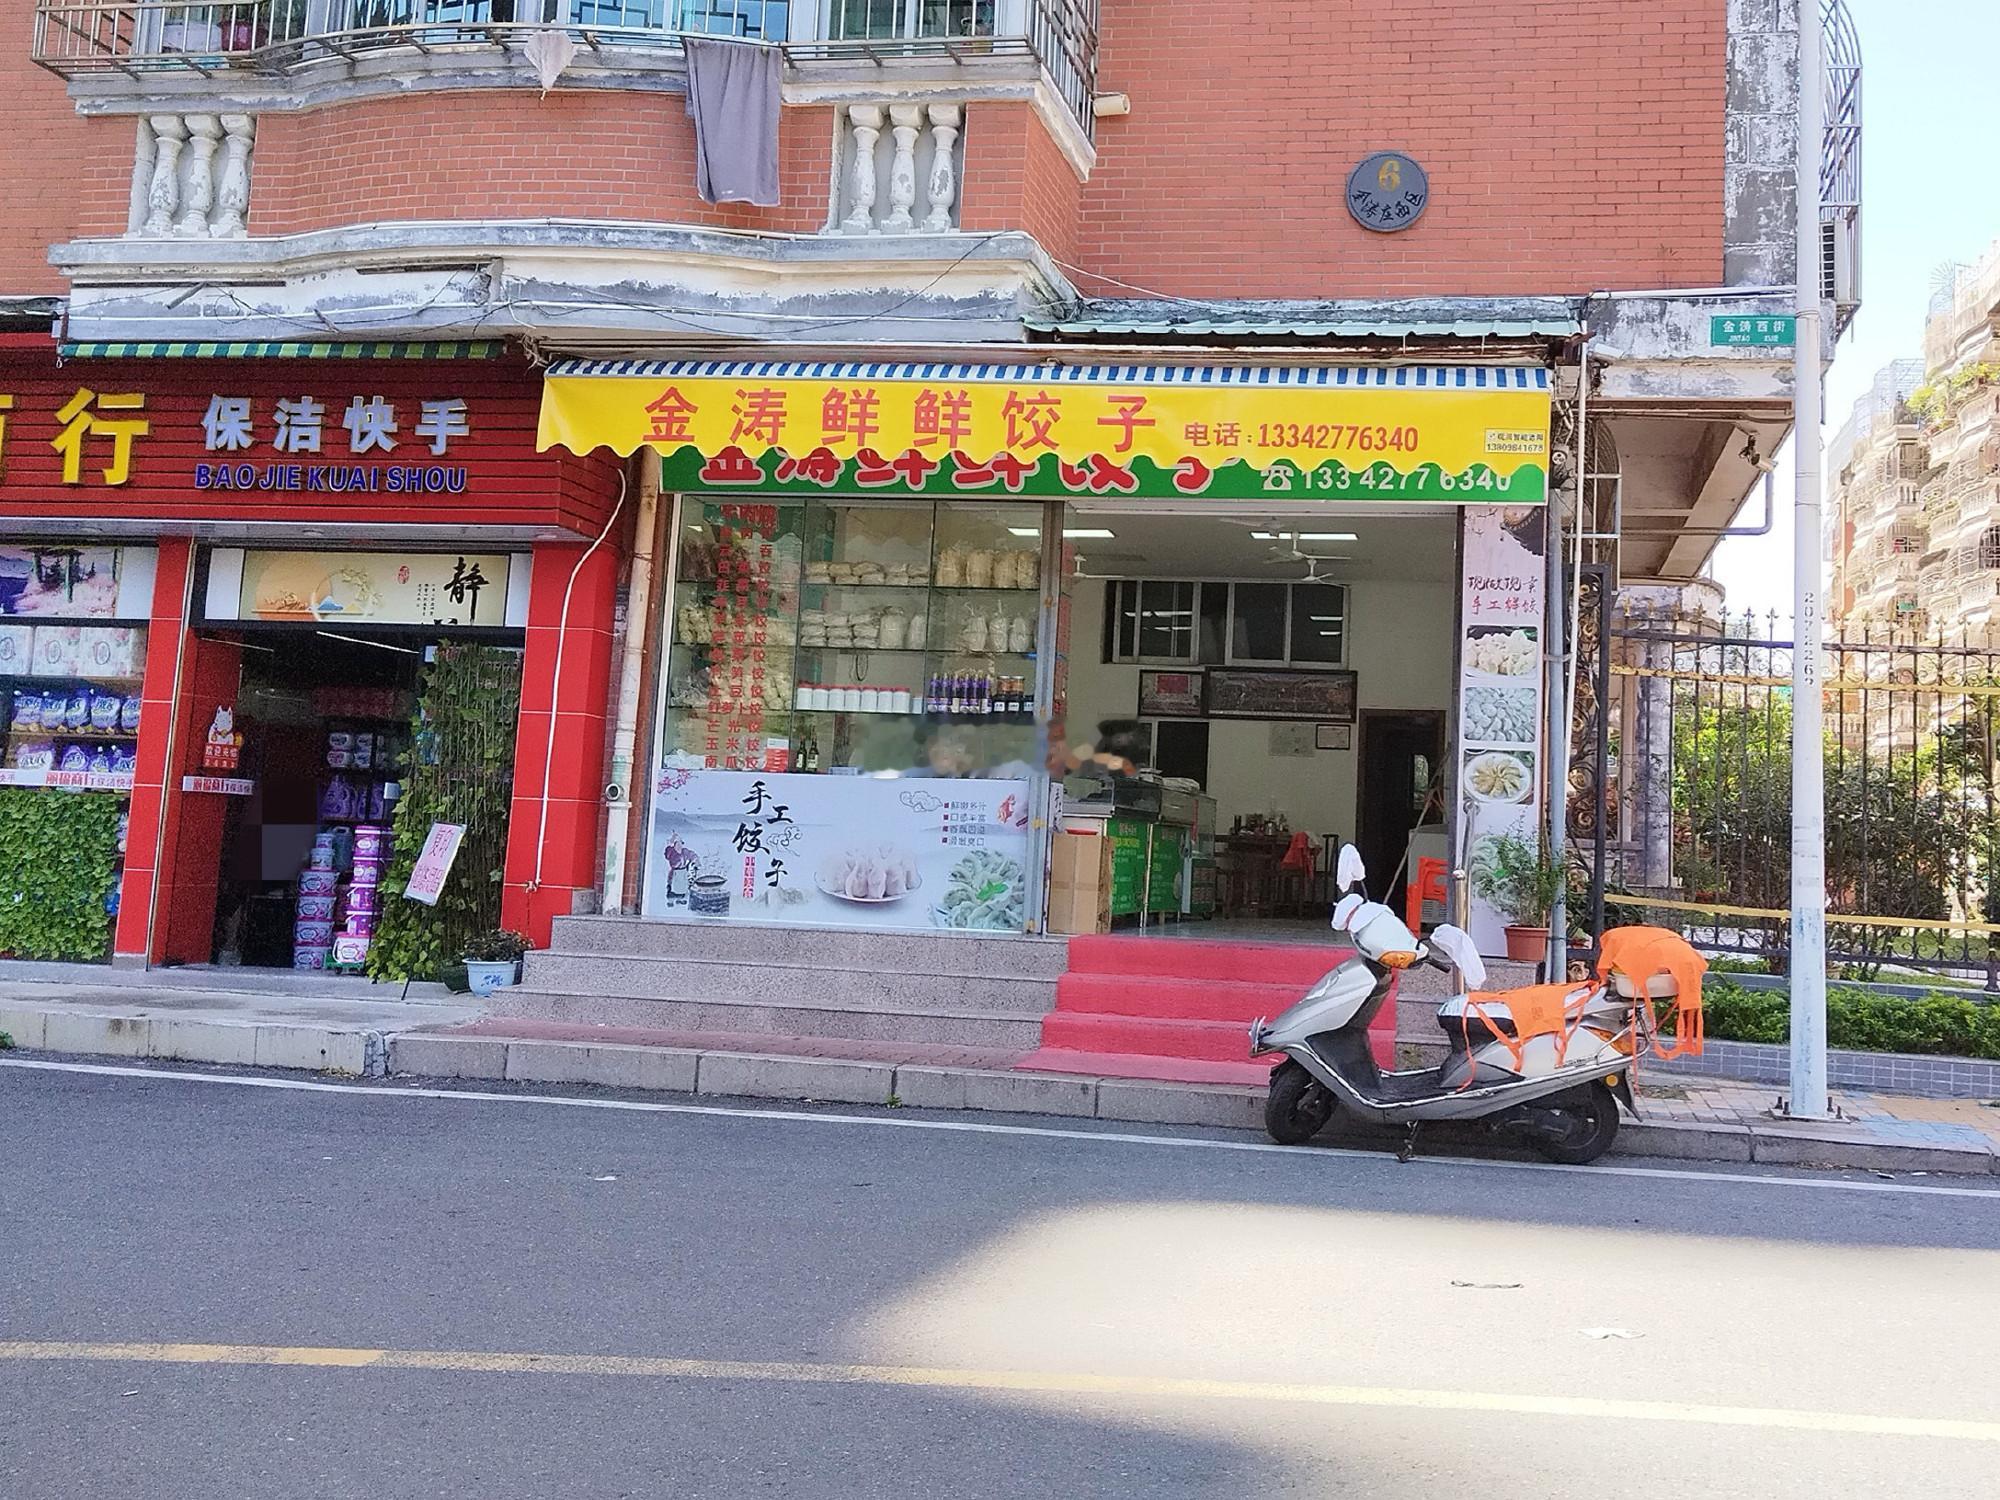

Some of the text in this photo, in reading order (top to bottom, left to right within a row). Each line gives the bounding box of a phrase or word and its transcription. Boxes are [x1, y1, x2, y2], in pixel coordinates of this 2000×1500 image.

[1378, 159, 1400, 192] 6
[0, 386, 149, 486] 行
[201, 394, 470, 457] 保洁快手
[642, 386, 1156, 451] 金涛鲜鲜饺子
